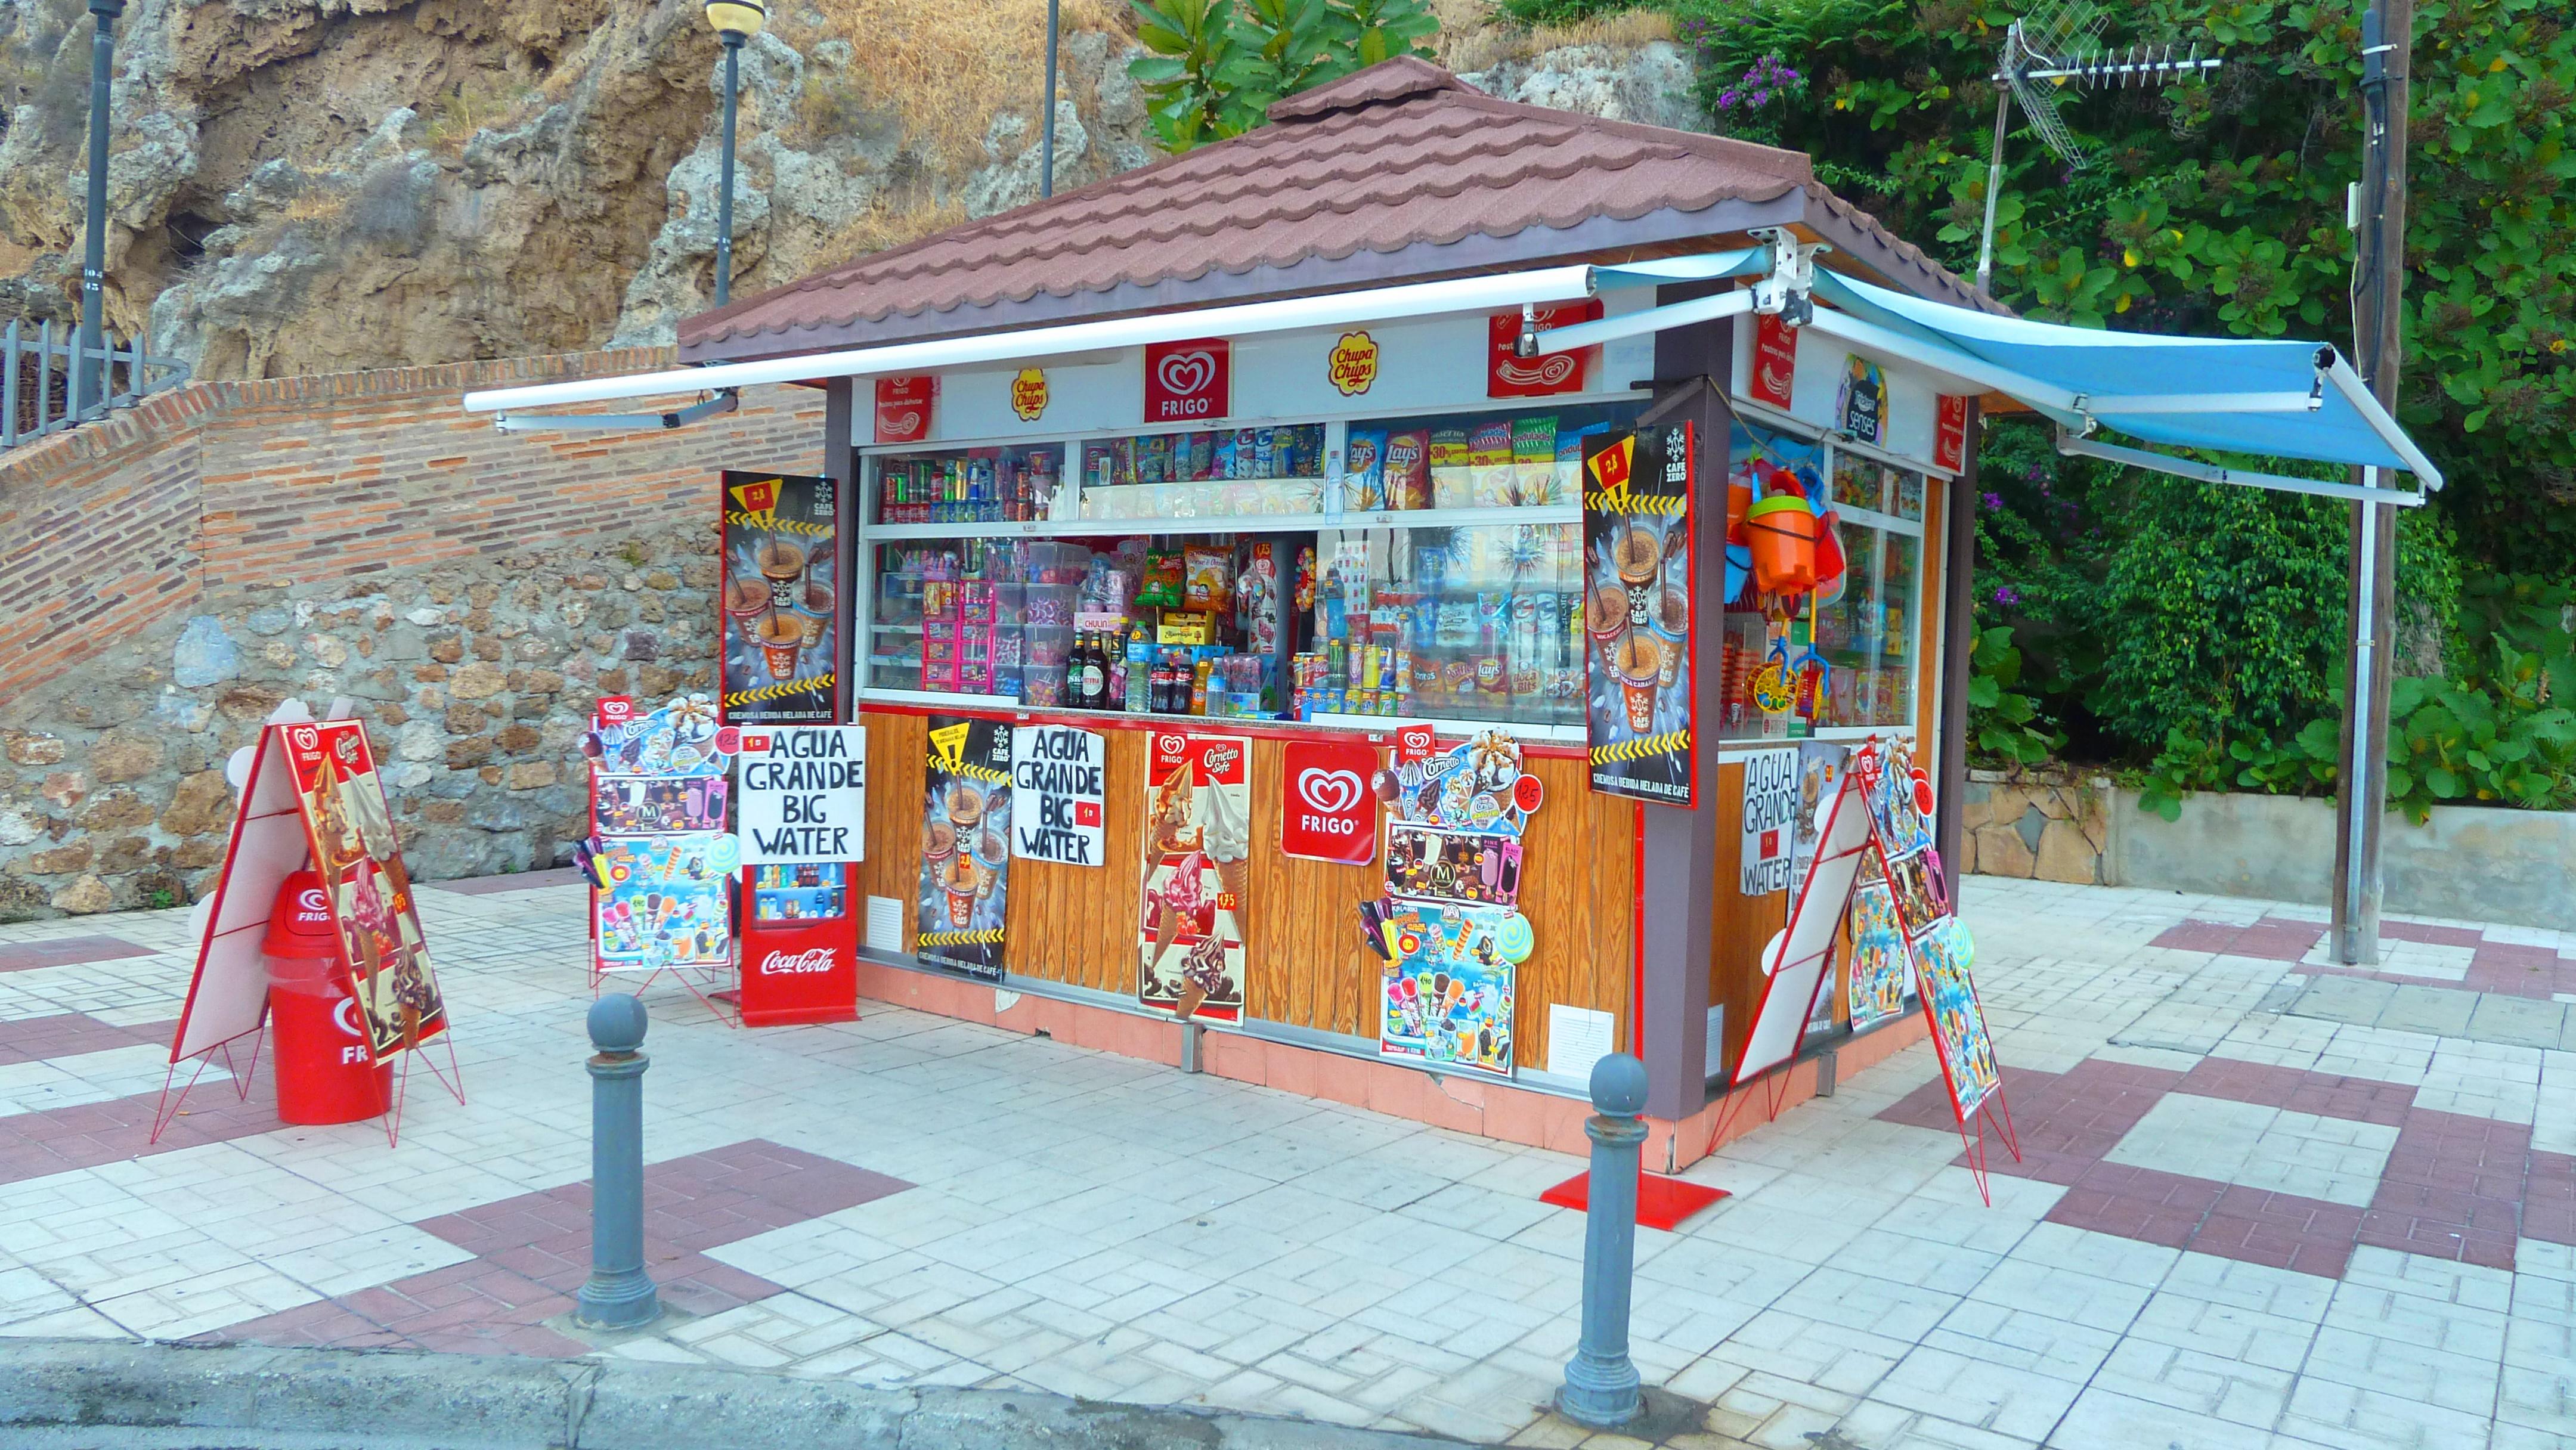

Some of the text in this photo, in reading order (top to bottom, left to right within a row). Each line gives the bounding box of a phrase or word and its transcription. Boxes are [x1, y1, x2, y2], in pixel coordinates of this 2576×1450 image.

[1336, 348, 1373, 366] Chupa
[1335, 363, 1371, 387] Chups
[1017, 380, 1045, 395] Chupa
[1015, 393, 1044, 413] Chups
[1161, 398, 1209, 416] FRIGO
[1850, 410, 1875, 436] senses
[1386, 445, 1419, 465] Lay's
[1666, 458, 1686, 473] CAFÉ
[1666, 472, 1687, 482] ZERO
[1478, 664, 1502, 680] Lay's
[816, 708, 832, 719] CAFÉ
[769, 729, 847, 759] AGUA
[1032, 731, 1089, 763] AGUA
[1160, 755, 1182, 764] FRIGO
[1203, 748, 1239, 768] Cornetto
[1212, 762, 1230, 774] Soft
[745, 759, 864, 791] GRANDE
[1016, 761, 1102, 795] GRANDE
[1422, 757, 1460, 782] Cornetto
[1746, 751, 1792, 796] AGUA
[1593, 773, 1689, 798] CREMOSA BEBIDA HELADA DE CAFÉ
[783, 794, 826, 824] BIG
[1041, 794, 1073, 829] BIG
[1301, 814, 1355, 835] FRIGO
[752, 827, 849, 856] WATER
[1019, 826, 1090, 865] WATER
[1436, 866, 1450, 881] M
[1744, 857, 1792, 895] WATER
[1219, 893, 1235, 909] 1,75
[298, 912, 331, 922] FRIG
[760, 947, 838, 975] Coca-Cola
[983, 965, 997, 977] CAFÉ
[1420, 976, 1432, 986] 1,40
